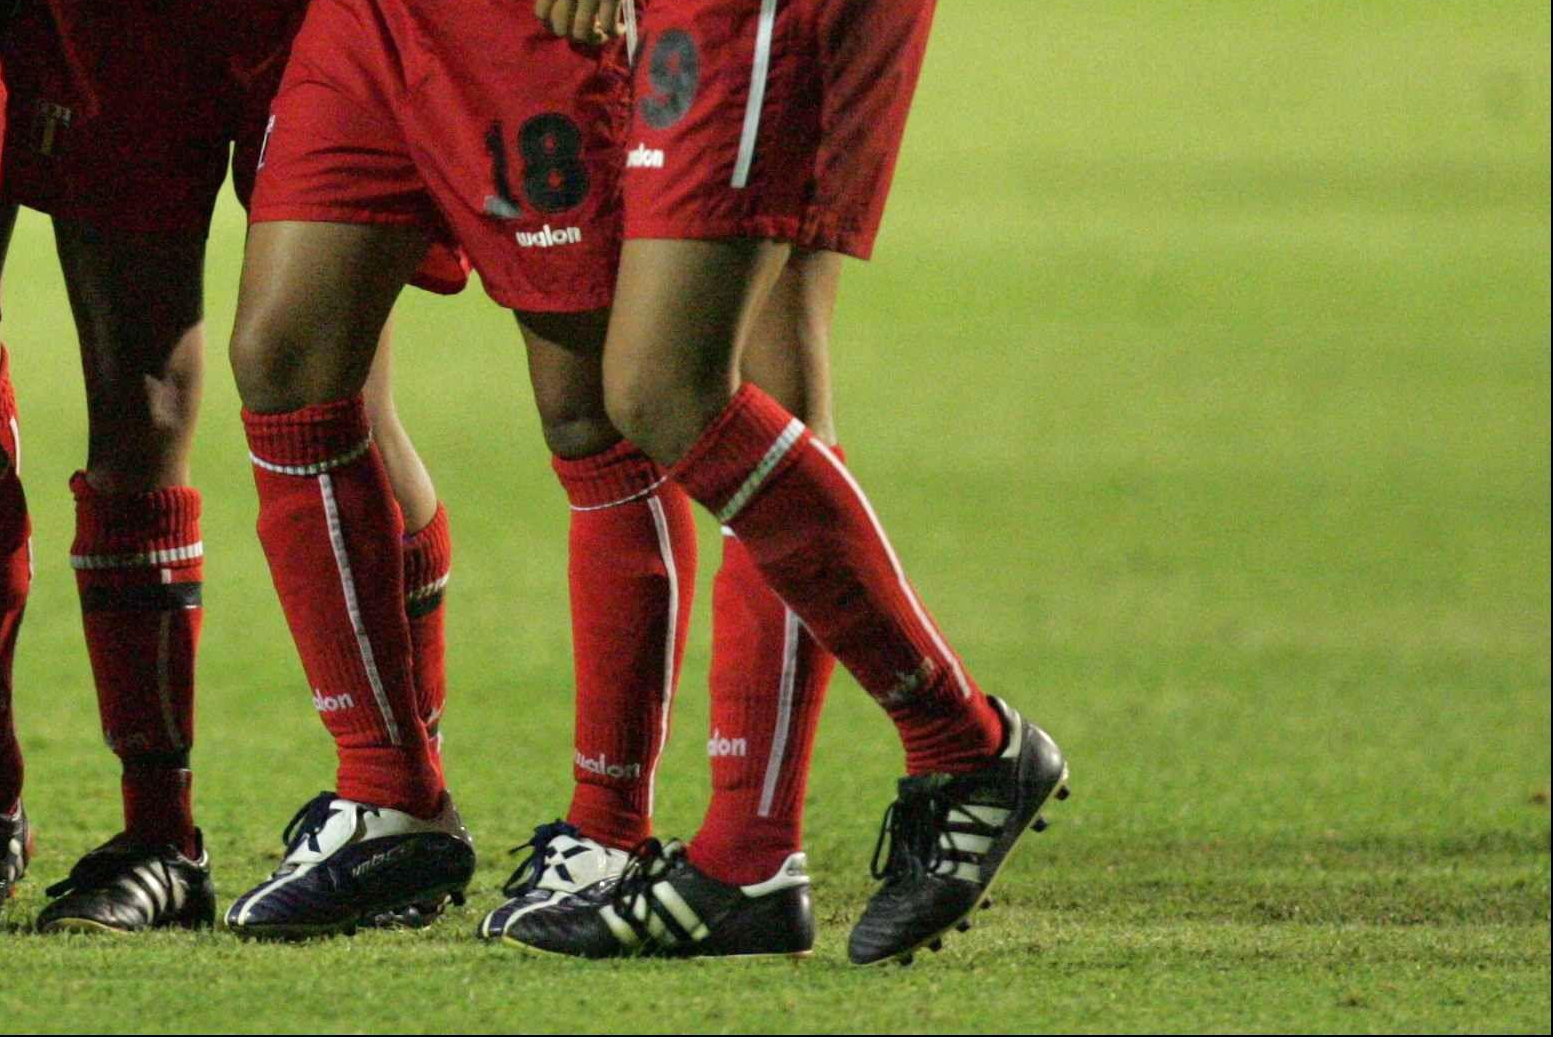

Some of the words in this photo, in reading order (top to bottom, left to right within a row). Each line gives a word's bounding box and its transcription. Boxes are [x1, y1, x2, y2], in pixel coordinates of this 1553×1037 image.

[640, 29, 699, 129] 9
[483, 112, 591, 219] 18
[515, 224, 581, 247] walon
[312, 688, 355, 711] alon
[706, 727, 747, 757] alon
